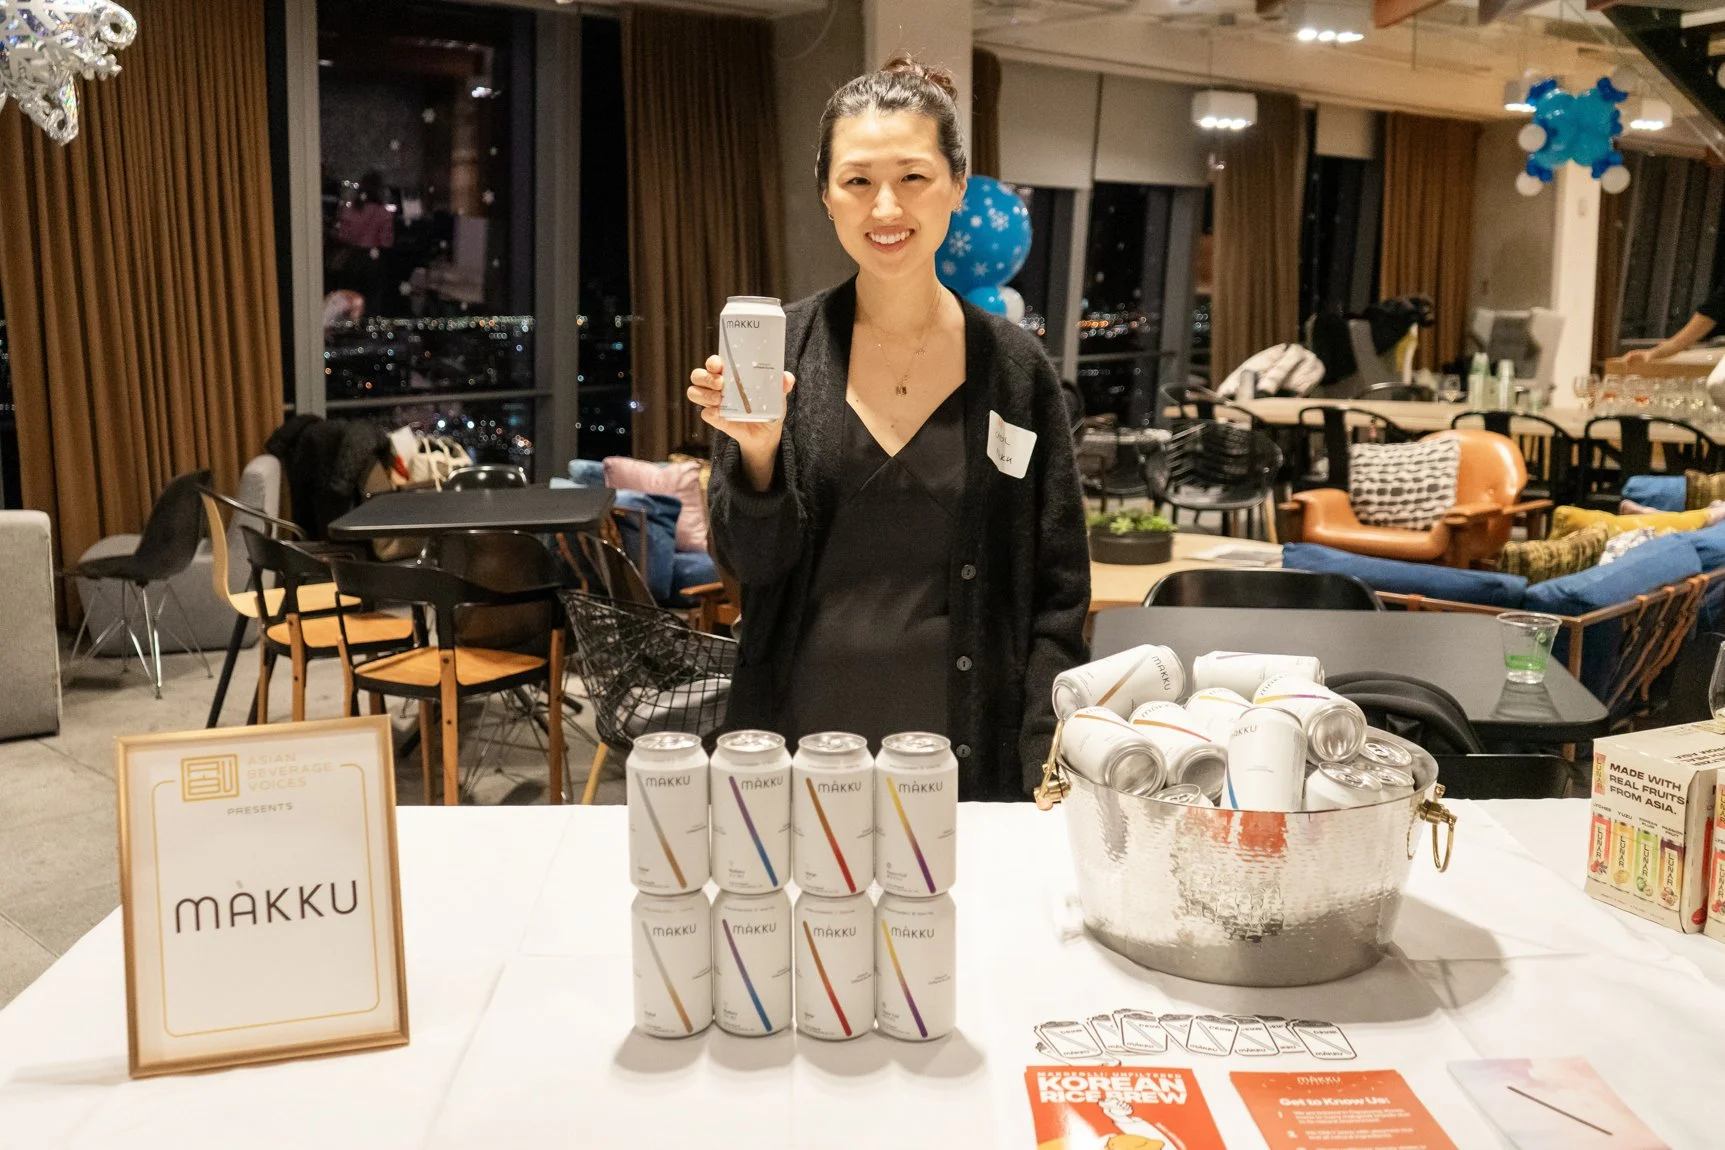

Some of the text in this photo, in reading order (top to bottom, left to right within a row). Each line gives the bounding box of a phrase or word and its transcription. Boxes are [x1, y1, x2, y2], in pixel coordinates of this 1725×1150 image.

[248, 753, 296, 766] ASIAN
[248, 762, 334, 780] BEVERAGE
[1610, 762, 1681, 792] MADE WITH
[248, 776, 307, 792] VOICES
[1610, 774, 1685, 805] REAL FRUITS
[228, 802, 293, 816] PRESENTS
[1610, 786, 1677, 815] FROM ASIA.
[1617, 811, 1632, 820] YUZU
[1618, 836, 1626, 868] LUNAR
[1642, 844, 1650, 877] LUNAR
[1666, 852, 1674, 886] LUNAR
[1038, 1076, 1186, 1093] KOREAN
[1040, 1090, 1188, 1104] RICE BREW
[1280, 1098, 1306, 1107] Get
[1306, 1098, 1322, 1106] to
[1322, 1097, 1365, 1106] Know
